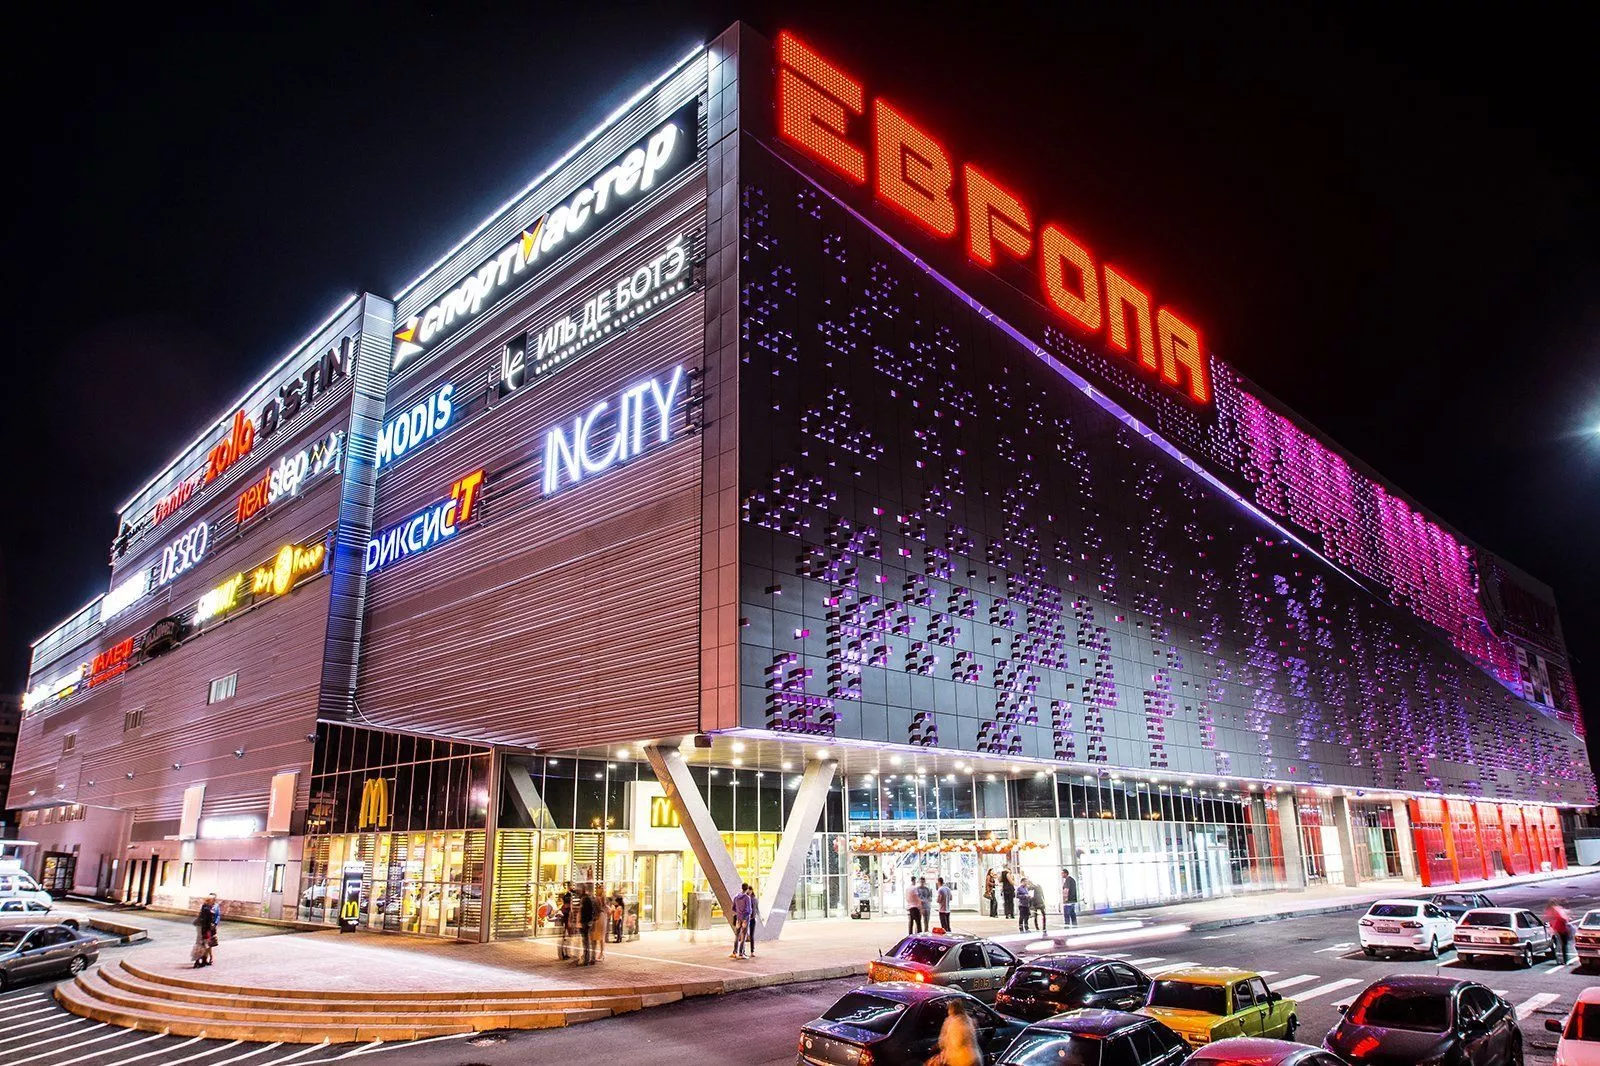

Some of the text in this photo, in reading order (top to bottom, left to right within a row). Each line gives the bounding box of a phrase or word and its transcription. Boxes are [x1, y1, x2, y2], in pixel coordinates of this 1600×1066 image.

[779, 29, 1207, 402] ЕВРОПА
[536, 316, 577, 360] ИЛЬ
[580, 289, 611, 338] ДЕ
[376, 383, 454, 469] MODIS
[543, 364, 685, 494] INCITY
[160, 522, 208, 585] DESEO
